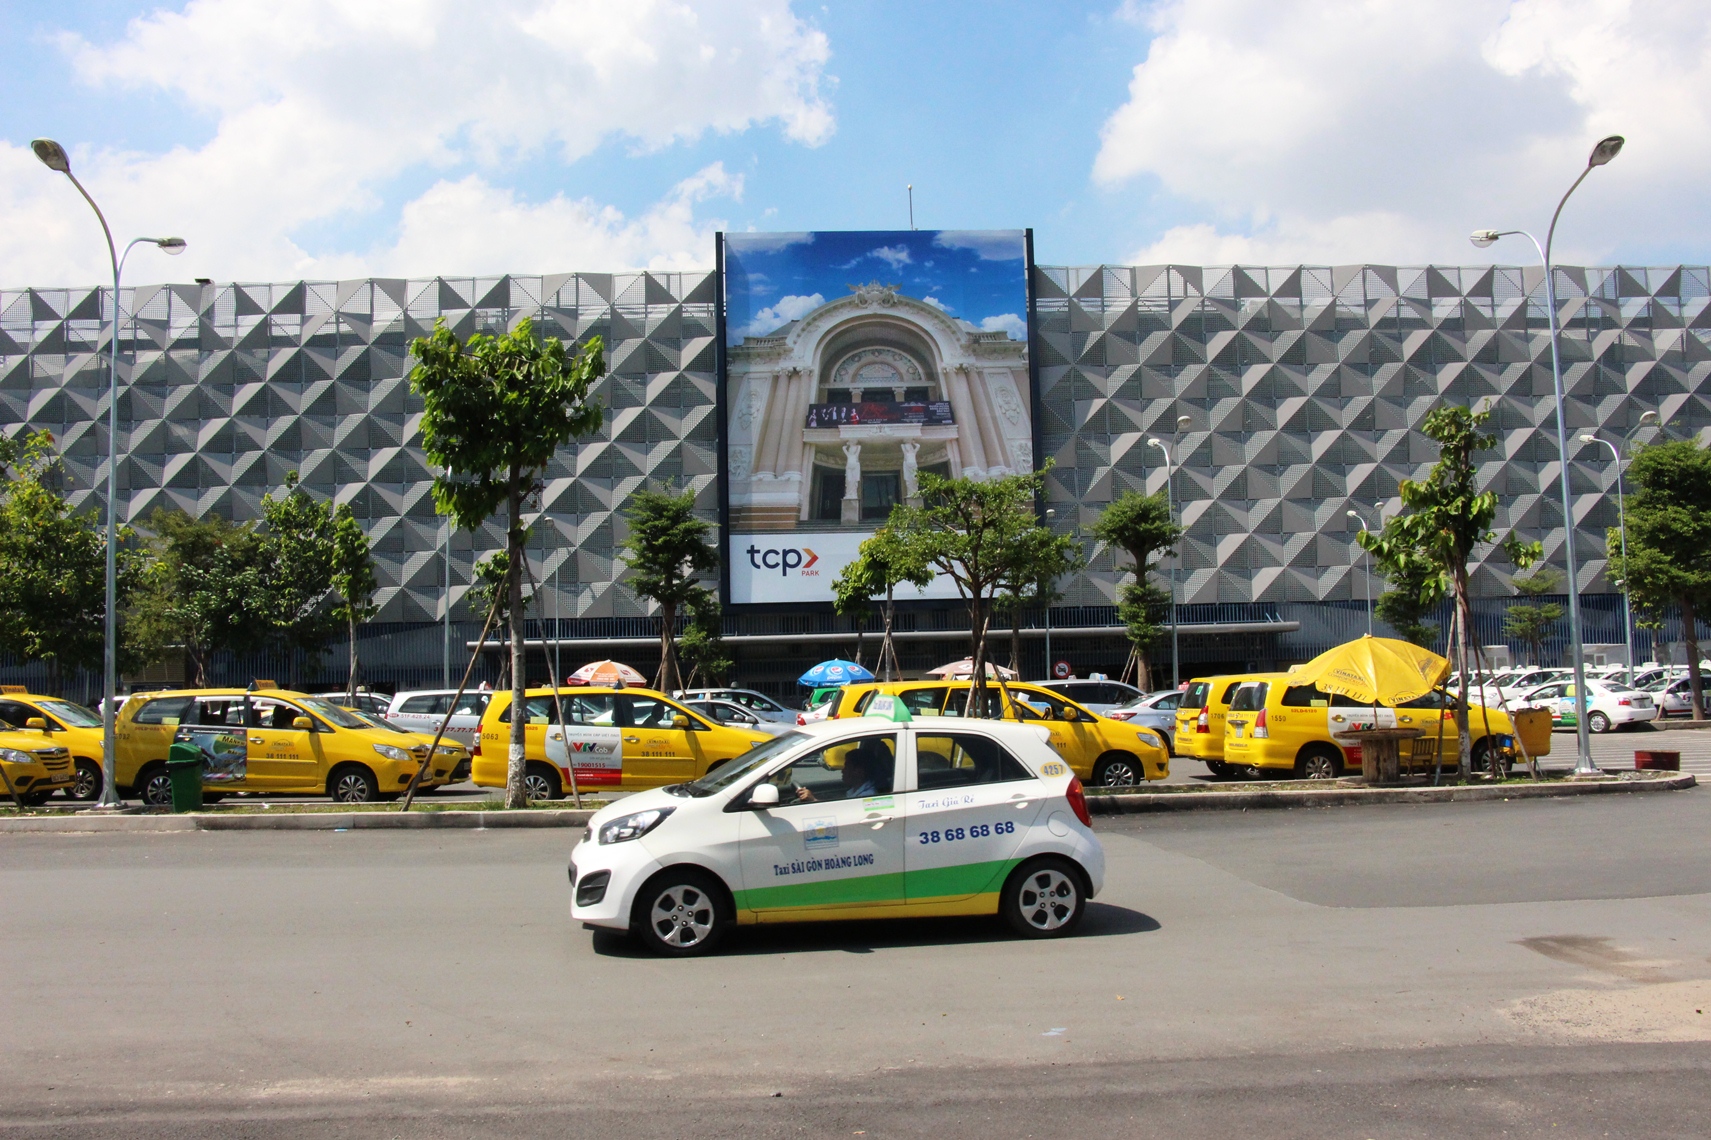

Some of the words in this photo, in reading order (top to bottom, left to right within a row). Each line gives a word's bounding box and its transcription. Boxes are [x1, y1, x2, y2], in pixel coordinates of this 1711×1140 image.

[746, 544, 802, 577] tcp
[1043, 764, 1064, 776] 4257
[919, 831, 941, 844] 38
[944, 827, 965, 841] 68
[969, 824, 990, 838] 68
[994, 821, 1015, 835] 68
[773, 863, 790, 876] Taxi
[791, 859, 805, 874] SÀI
[806, 857, 823, 872] GÒN
[824, 855, 851, 870] HOÀNG
[853, 853, 874, 867] LONG
